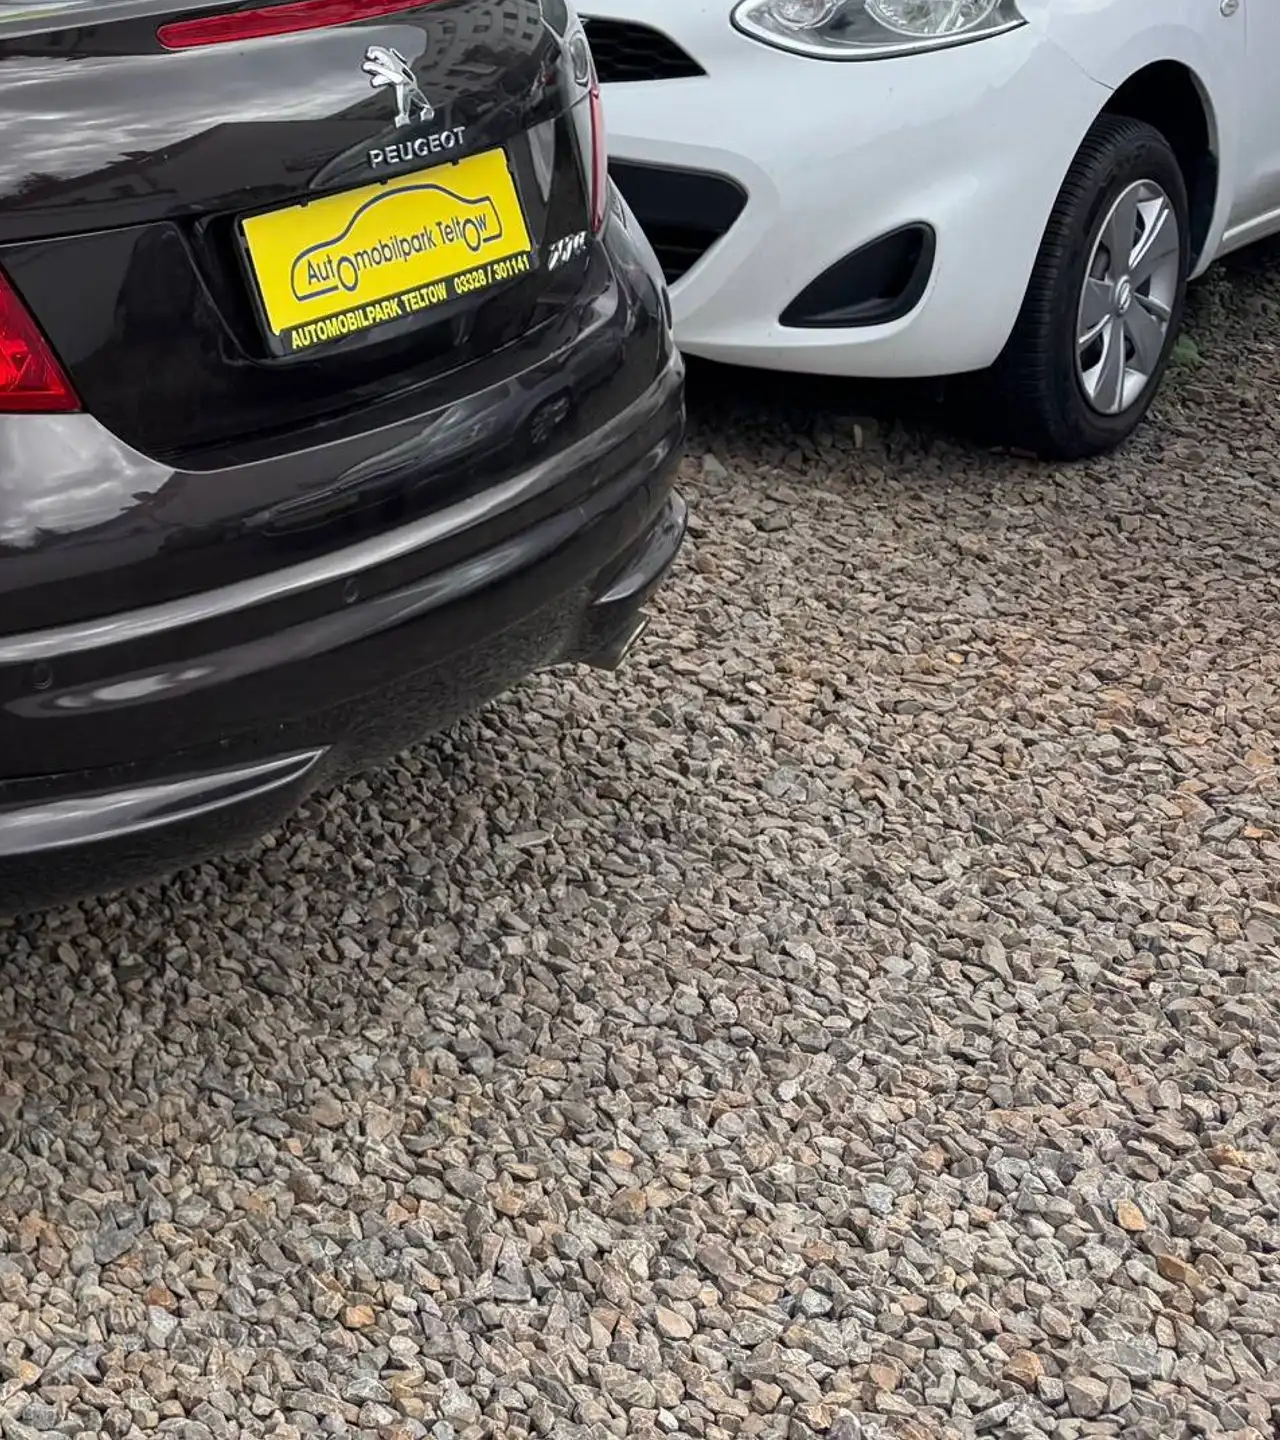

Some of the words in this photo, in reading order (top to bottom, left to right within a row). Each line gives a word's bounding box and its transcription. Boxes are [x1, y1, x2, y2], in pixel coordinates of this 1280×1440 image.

[369, 126, 467, 168] PEUGEOT
[291, 299, 402, 350] AUTOMOBILPARK
[402, 281, 448, 312] TELTOW
[453, 267, 486, 296] 03328
[494, 252, 531, 282] 301141
